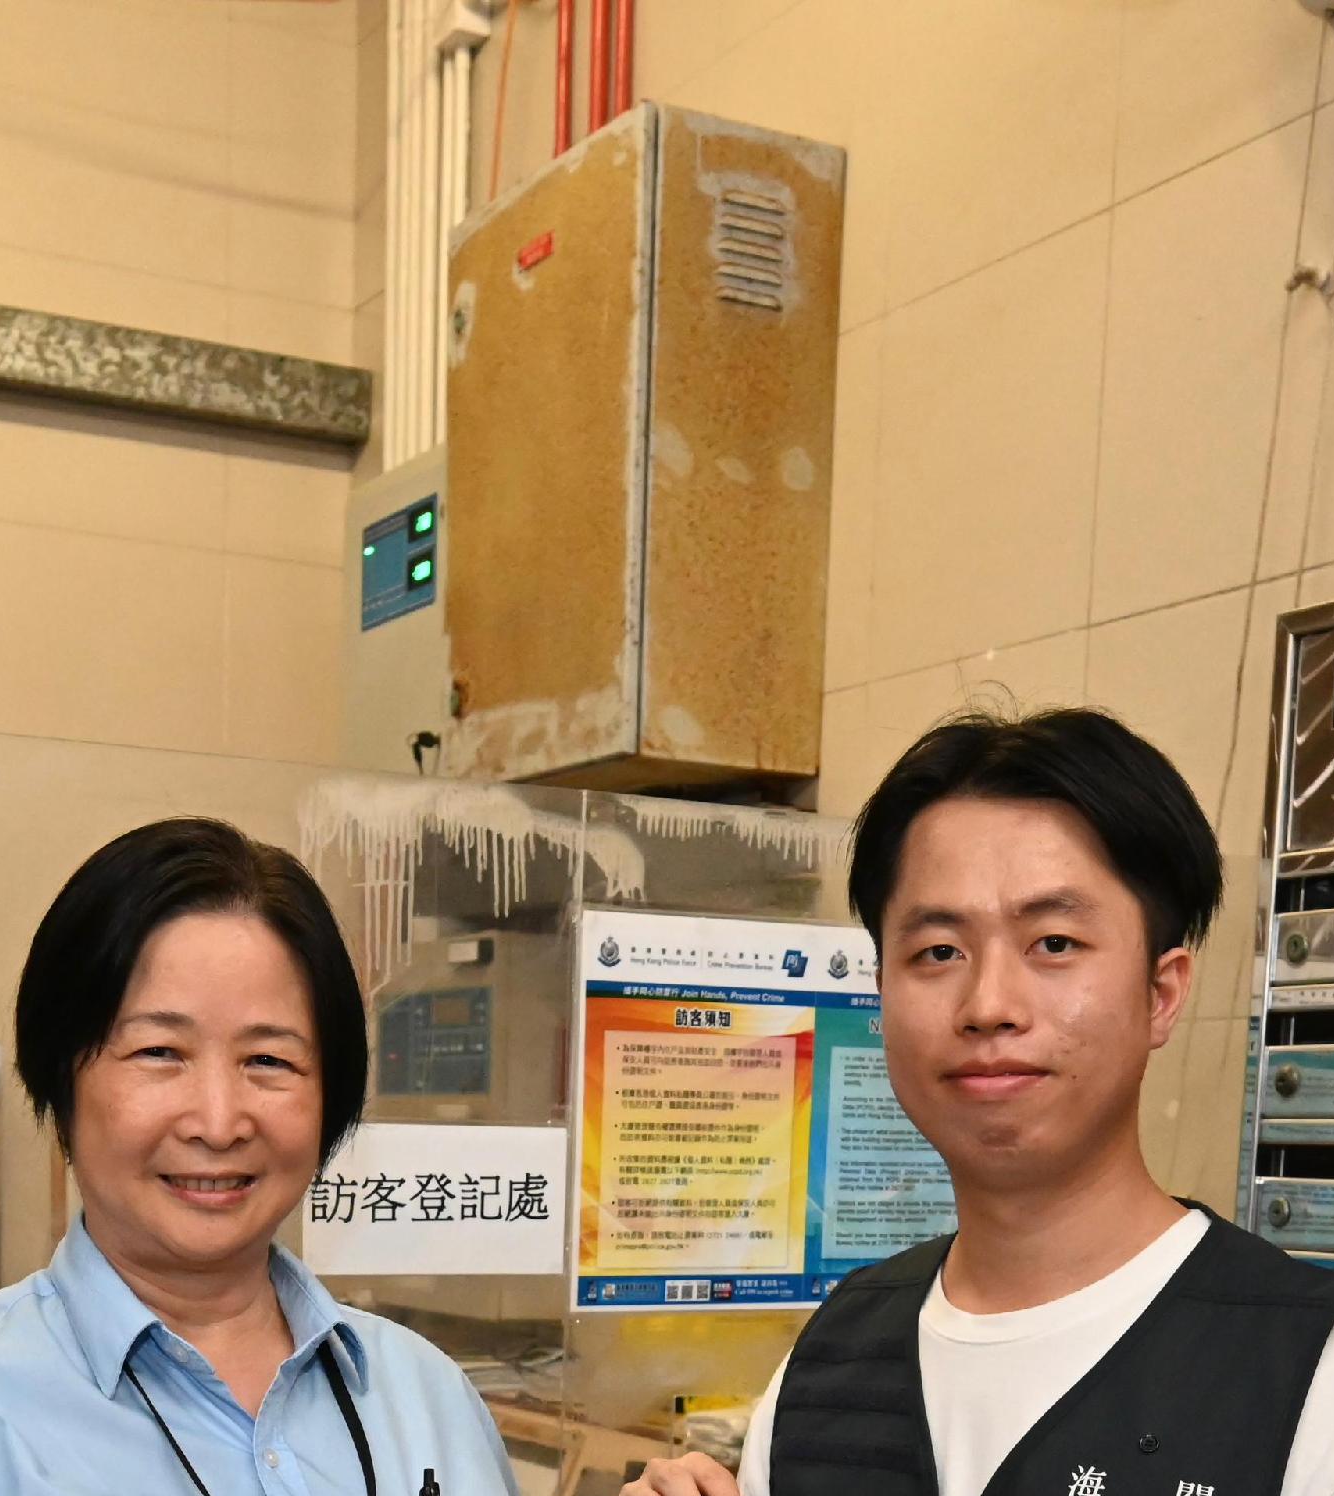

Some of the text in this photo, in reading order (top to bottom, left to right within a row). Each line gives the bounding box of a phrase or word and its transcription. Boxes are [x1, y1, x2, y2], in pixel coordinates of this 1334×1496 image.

[681, 988, 698, 999] Join
[700, 989, 728, 1001] Hands,
[730, 991, 761, 1002] Prevent
[762, 993, 785, 1003] Crime
[675, 1008, 731, 1028] 訪客須知
[310, 1172, 550, 1224] 訪客登記處
